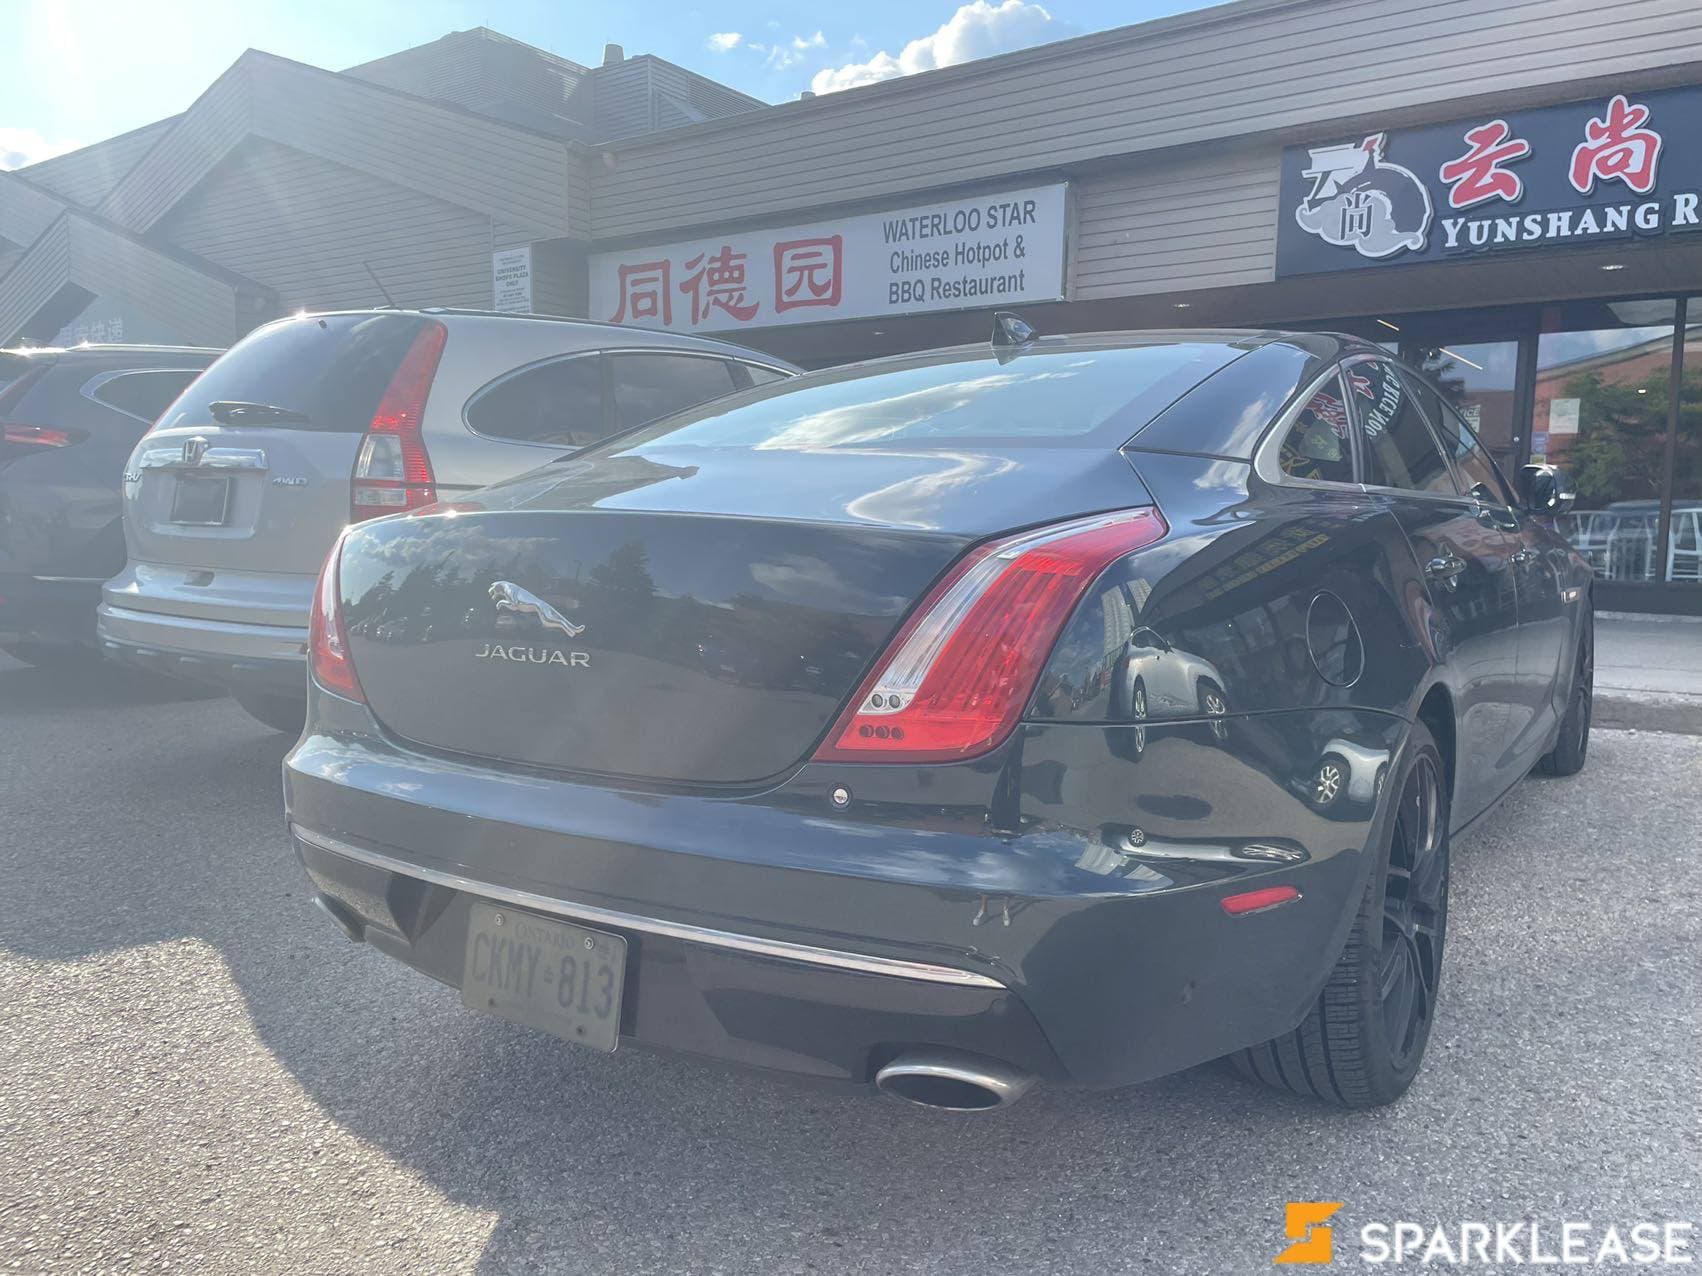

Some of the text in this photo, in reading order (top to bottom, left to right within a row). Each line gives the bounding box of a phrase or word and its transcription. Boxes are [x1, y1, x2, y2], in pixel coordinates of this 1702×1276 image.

[1439, 94, 1662, 210] 云尚
[883, 200, 1036, 243] WATERLOO STAR
[1441, 203, 1660, 247] YUNSHANG
[890, 234, 1026, 273] Chinese Hotpot &
[609, 235, 843, 326] 同德园
[888, 269, 1025, 304] BBQ Restaurant
[475, 644, 592, 668] JAGUAR
[515, 921, 575, 949] ONTARIO
[557, 955, 616, 1020] 813
